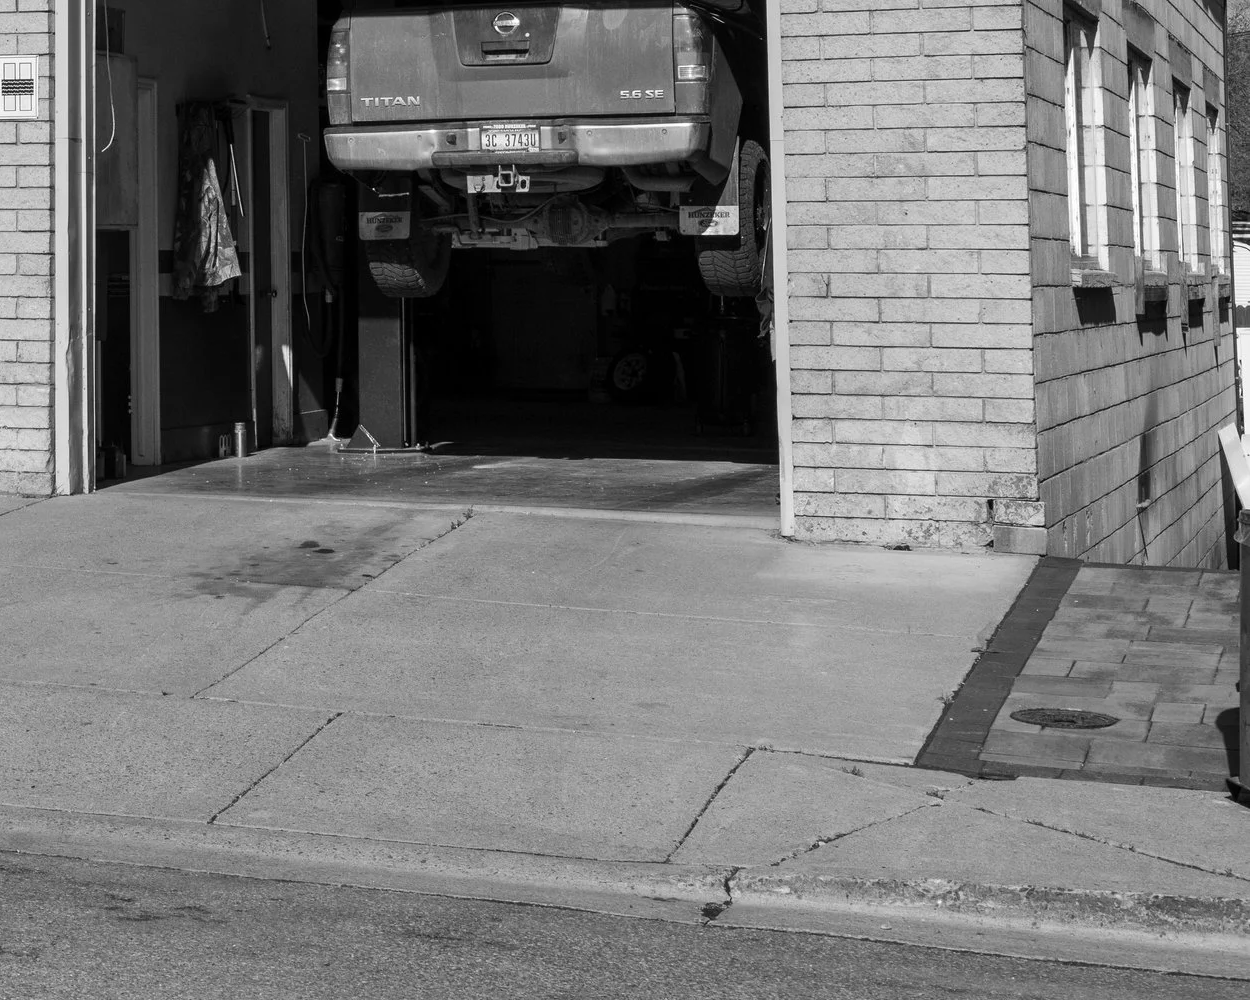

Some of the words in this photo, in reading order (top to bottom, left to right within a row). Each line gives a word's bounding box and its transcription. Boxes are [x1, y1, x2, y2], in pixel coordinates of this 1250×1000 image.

[644, 89, 665, 99] SE
[360, 95, 420, 107] TITAN
[485, 134, 497, 147] 3C
[505, 133, 535, 146] 3743U
[687, 211, 730, 219] HUNZEKER
